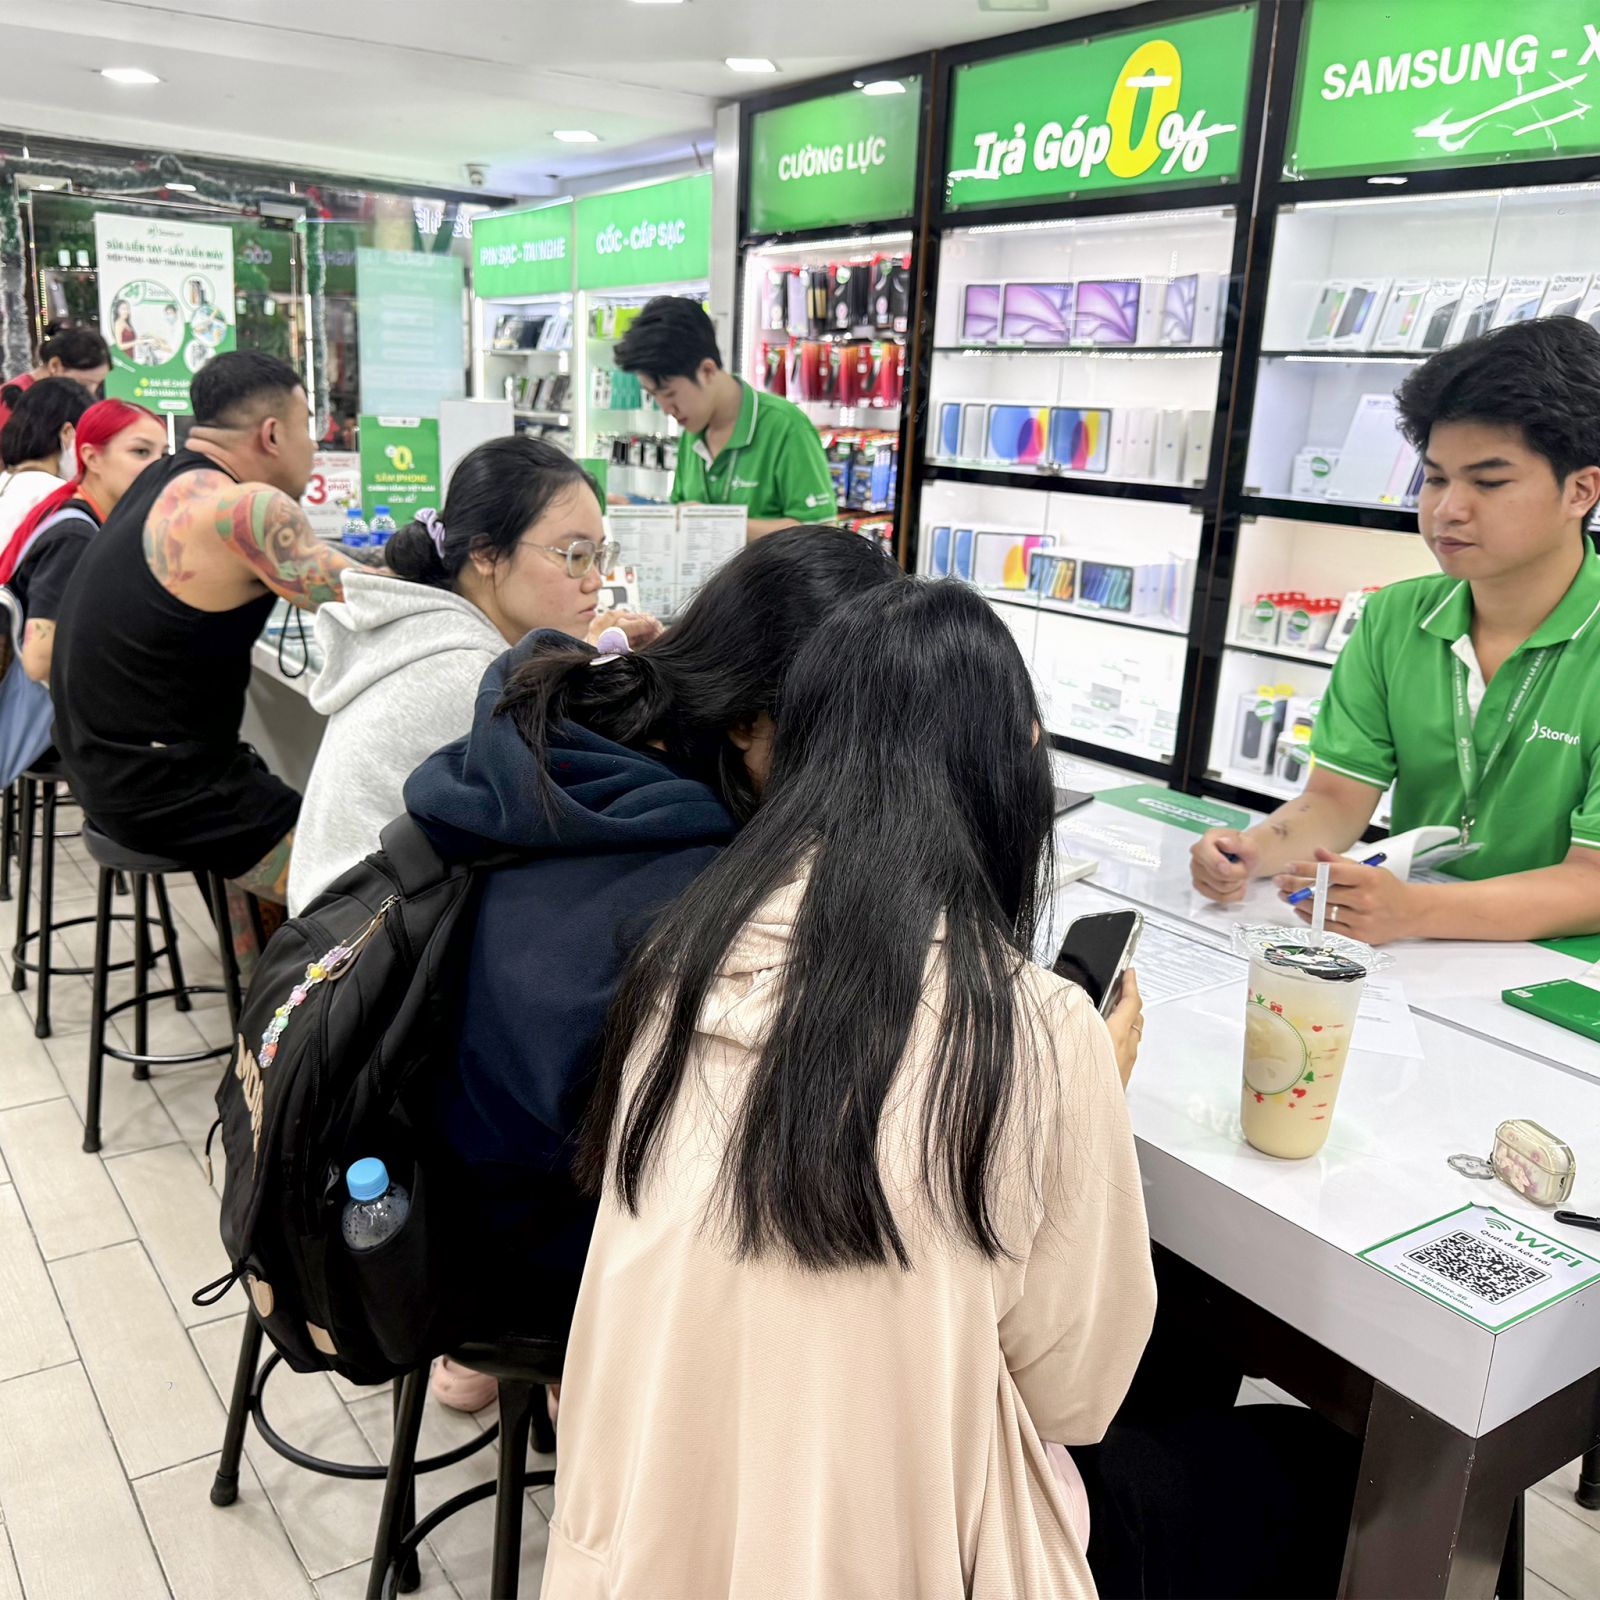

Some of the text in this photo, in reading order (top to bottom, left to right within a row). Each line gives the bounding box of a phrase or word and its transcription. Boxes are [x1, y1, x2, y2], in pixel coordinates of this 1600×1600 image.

[1320, 33, 1539, 101] SAMSUNG
[778, 136, 887, 182] CƯỜNG LỰC
[973, 123, 1027, 176] Trả
[1034, 115, 1111, 178] Góp
[595, 223, 623, 256] CỐC
[658, 219, 686, 251] SẠC
[1515, 1231, 1584, 1268] WIFI
